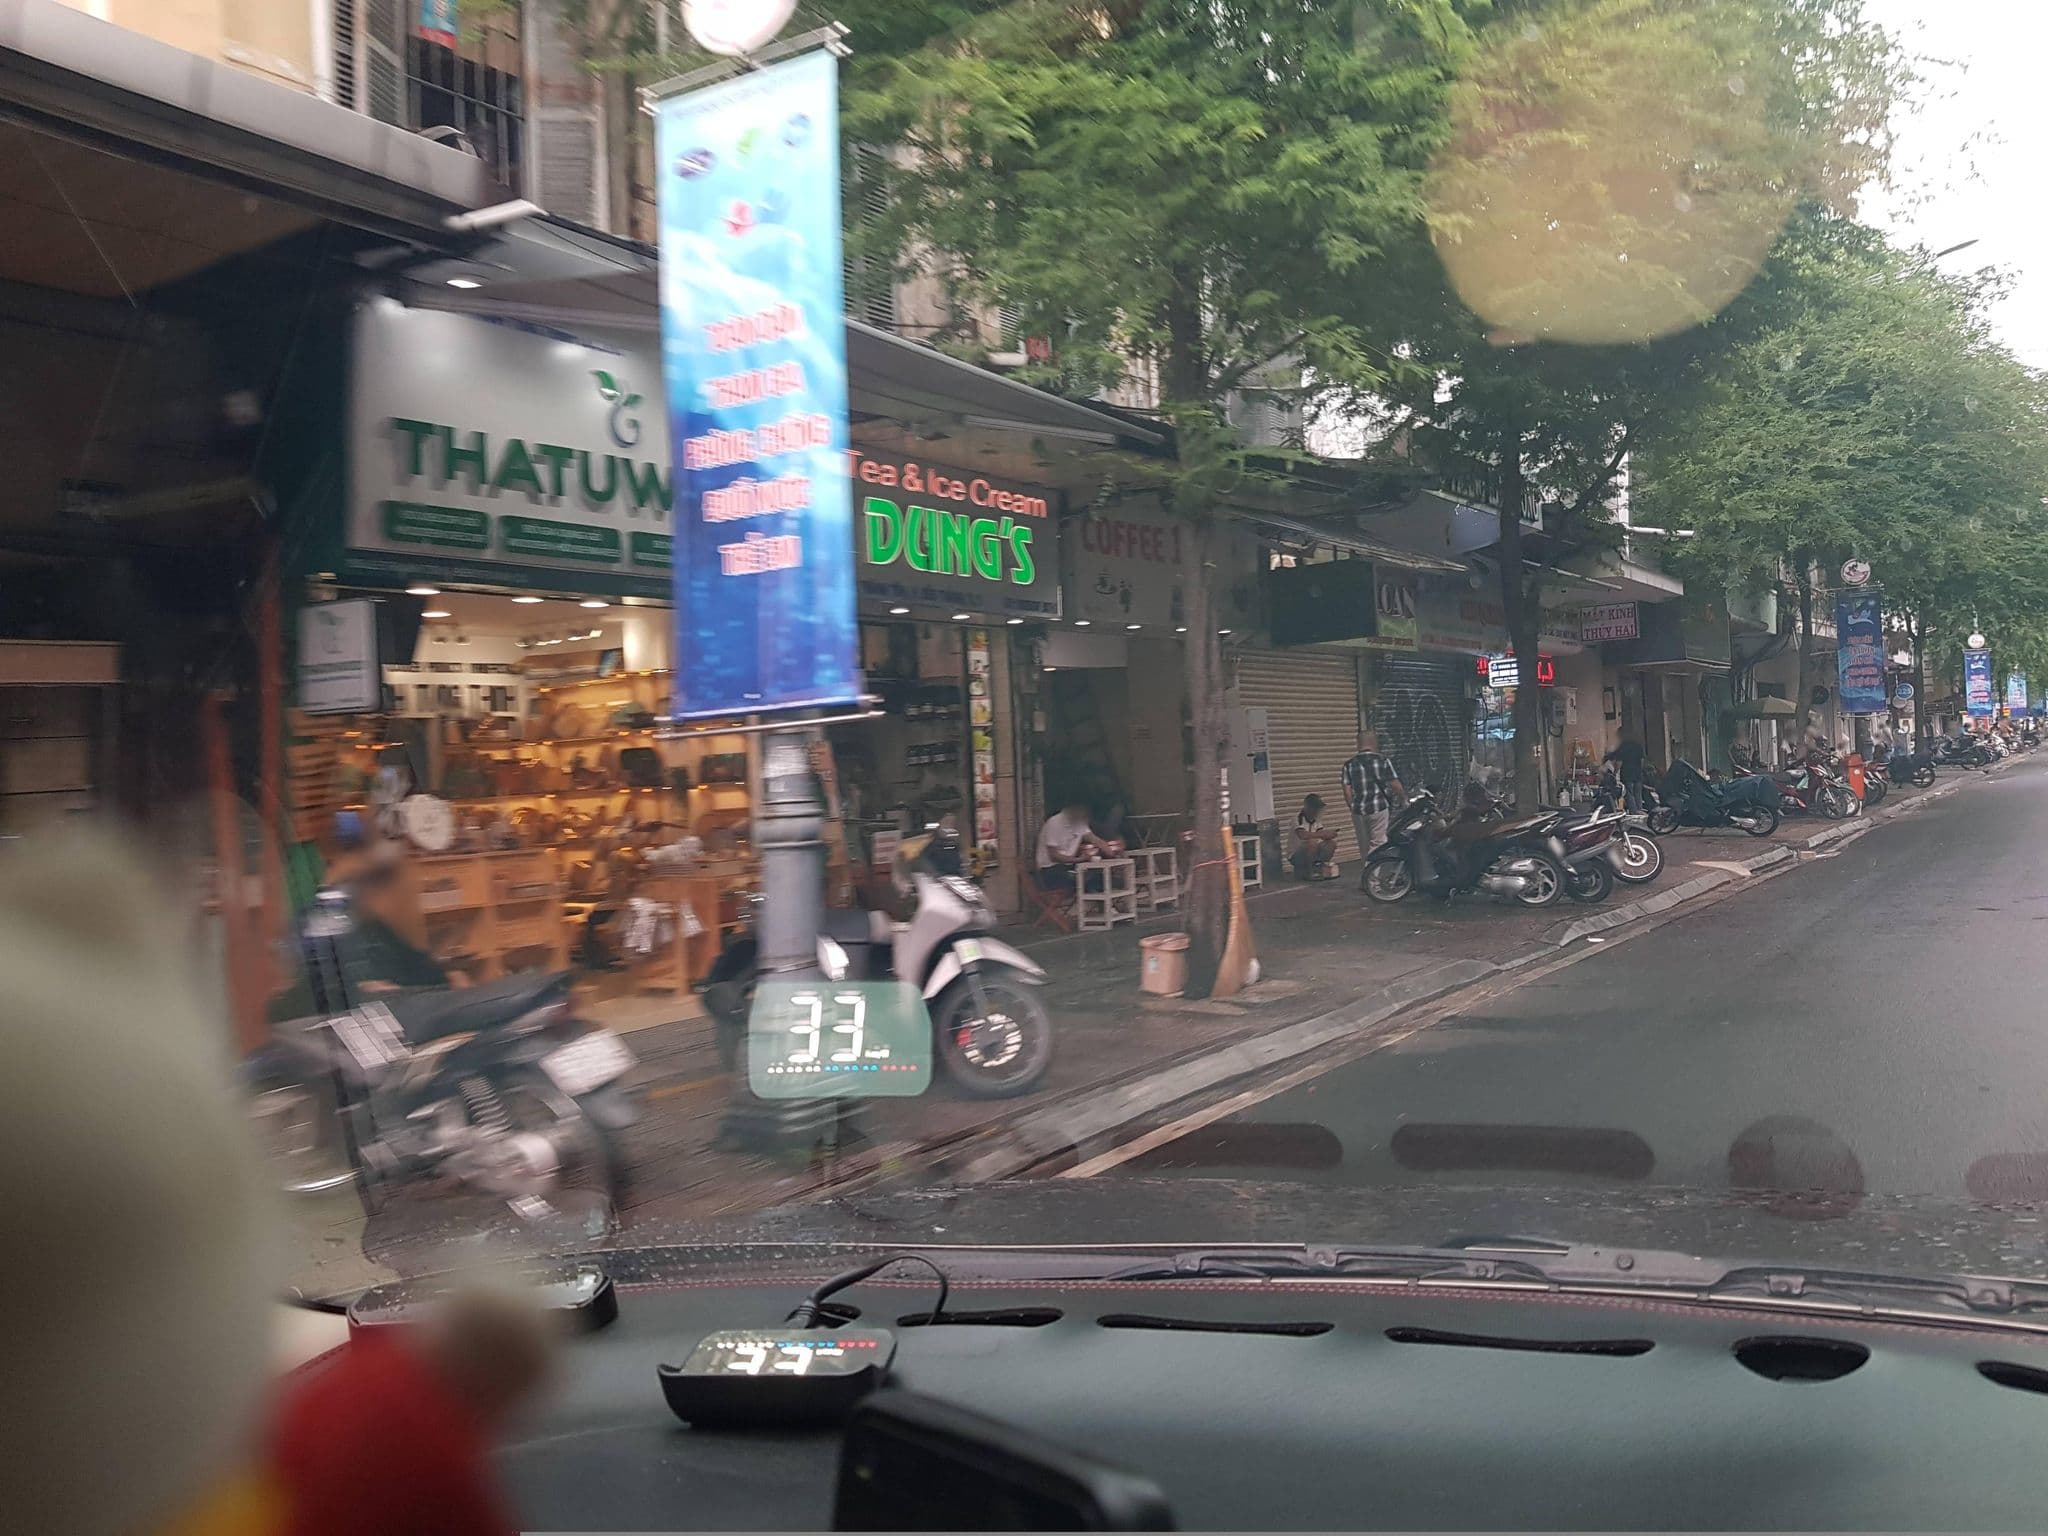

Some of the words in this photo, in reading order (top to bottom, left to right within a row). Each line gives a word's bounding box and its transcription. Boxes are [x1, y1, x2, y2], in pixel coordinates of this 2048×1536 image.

[844, 448, 898, 487] Tea
[901, 463, 925, 492] &
[927, 468, 967, 501] Ice
[969, 478, 1047, 518] Cream
[1081, 518, 1166, 562] COFFEE
[788, 995, 866, 1063] 33
